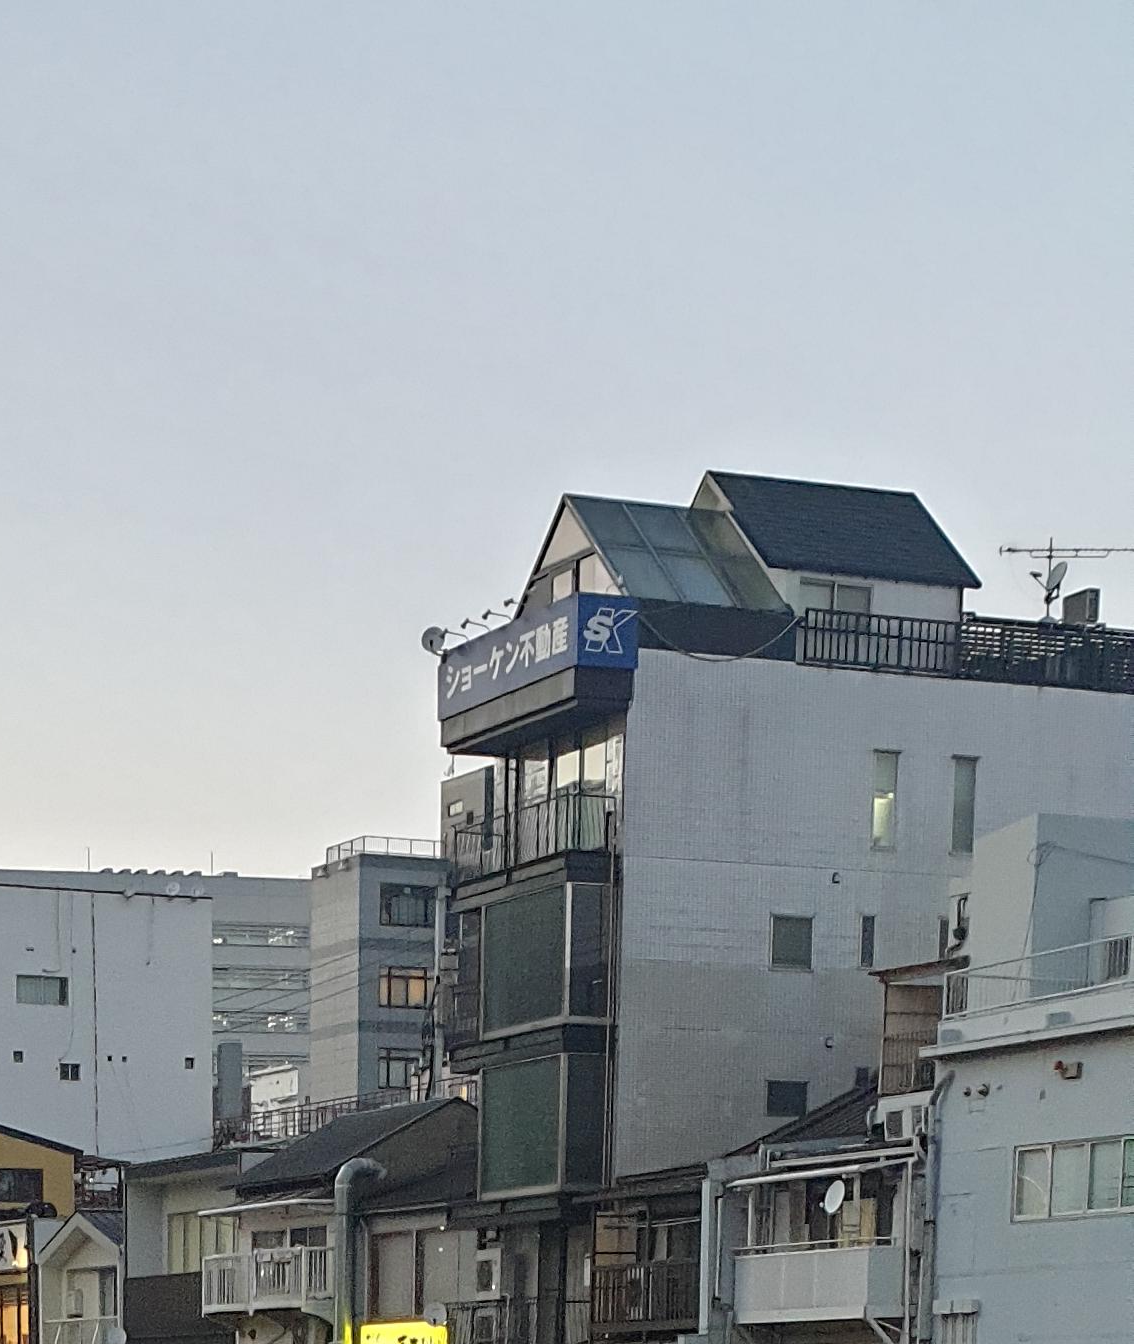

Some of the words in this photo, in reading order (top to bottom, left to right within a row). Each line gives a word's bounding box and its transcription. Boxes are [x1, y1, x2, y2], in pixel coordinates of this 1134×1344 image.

[446, 616, 568, 699] ショーケン不動産
